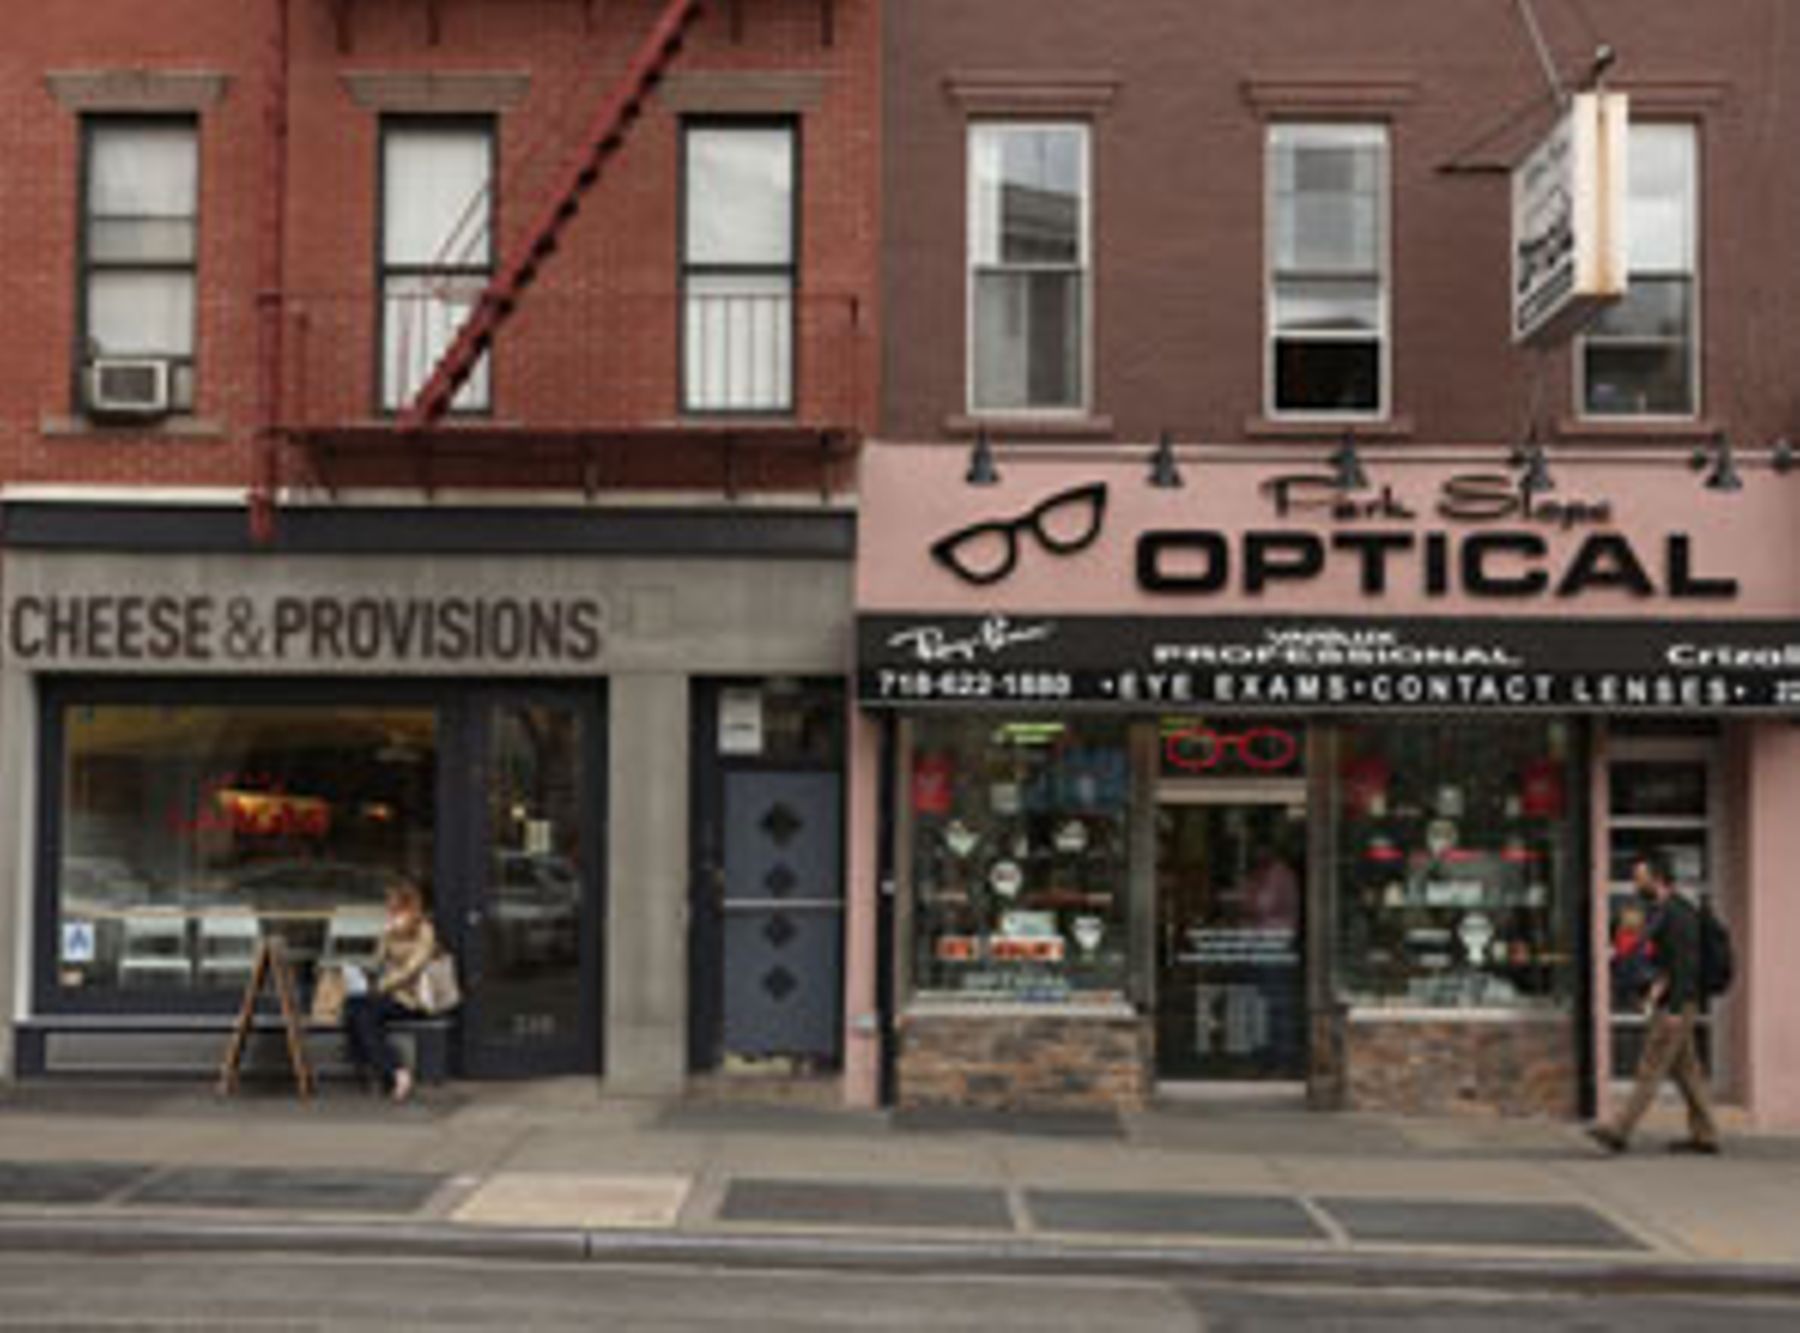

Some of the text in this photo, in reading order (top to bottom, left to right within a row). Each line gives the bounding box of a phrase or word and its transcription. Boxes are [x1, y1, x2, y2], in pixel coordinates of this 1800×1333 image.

[1259, 474, 1611, 531] Park Slope
[1135, 530, 1739, 597] OPTICAL
[9, 596, 601, 660] CHEESE & PROVISIONS
[1153, 644, 1523, 665] PROFESSIONAL
[1119, 672, 1728, 702] EYE EXAMS CONTACT LENSES
